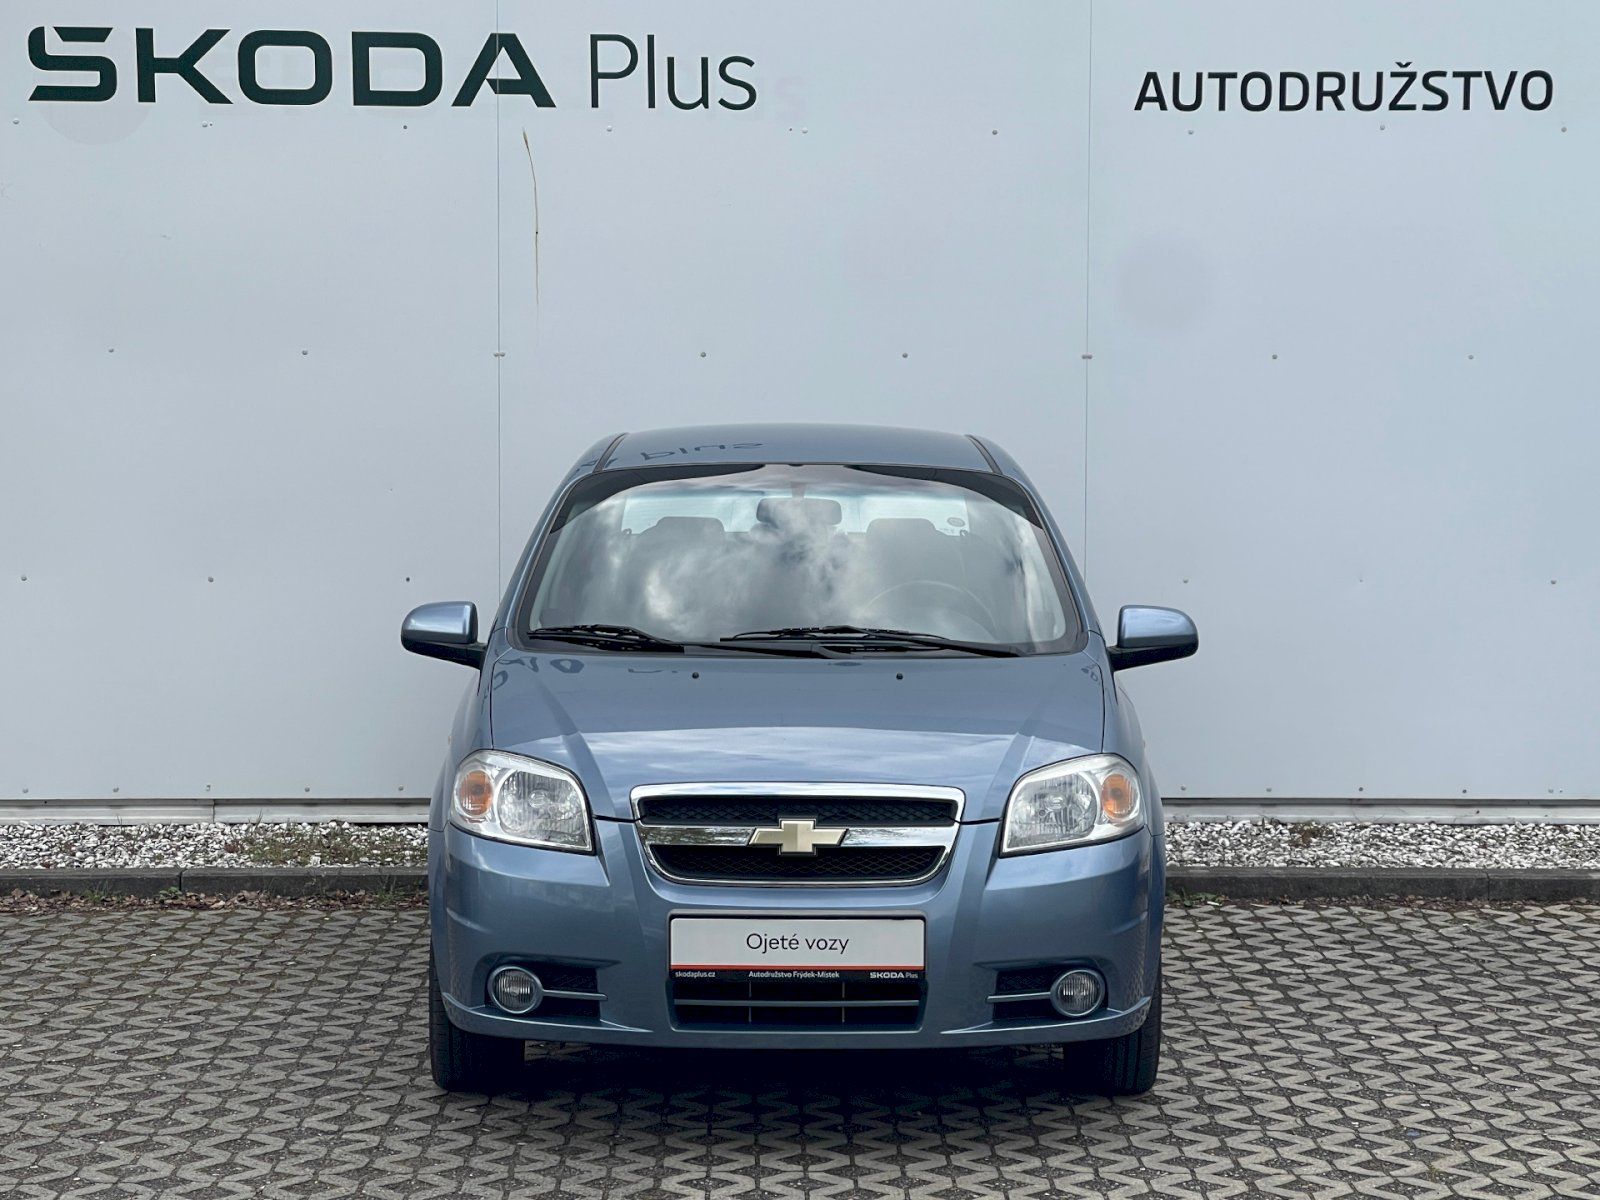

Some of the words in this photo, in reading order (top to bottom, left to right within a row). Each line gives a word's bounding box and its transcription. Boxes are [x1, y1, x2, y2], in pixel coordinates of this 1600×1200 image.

[589, 33, 758, 111] Plus
[1133, 61, 1555, 112] AUTODRUŽSTVO
[746, 932, 800, 954] Ojeté
[804, 937, 850, 955] vozy
